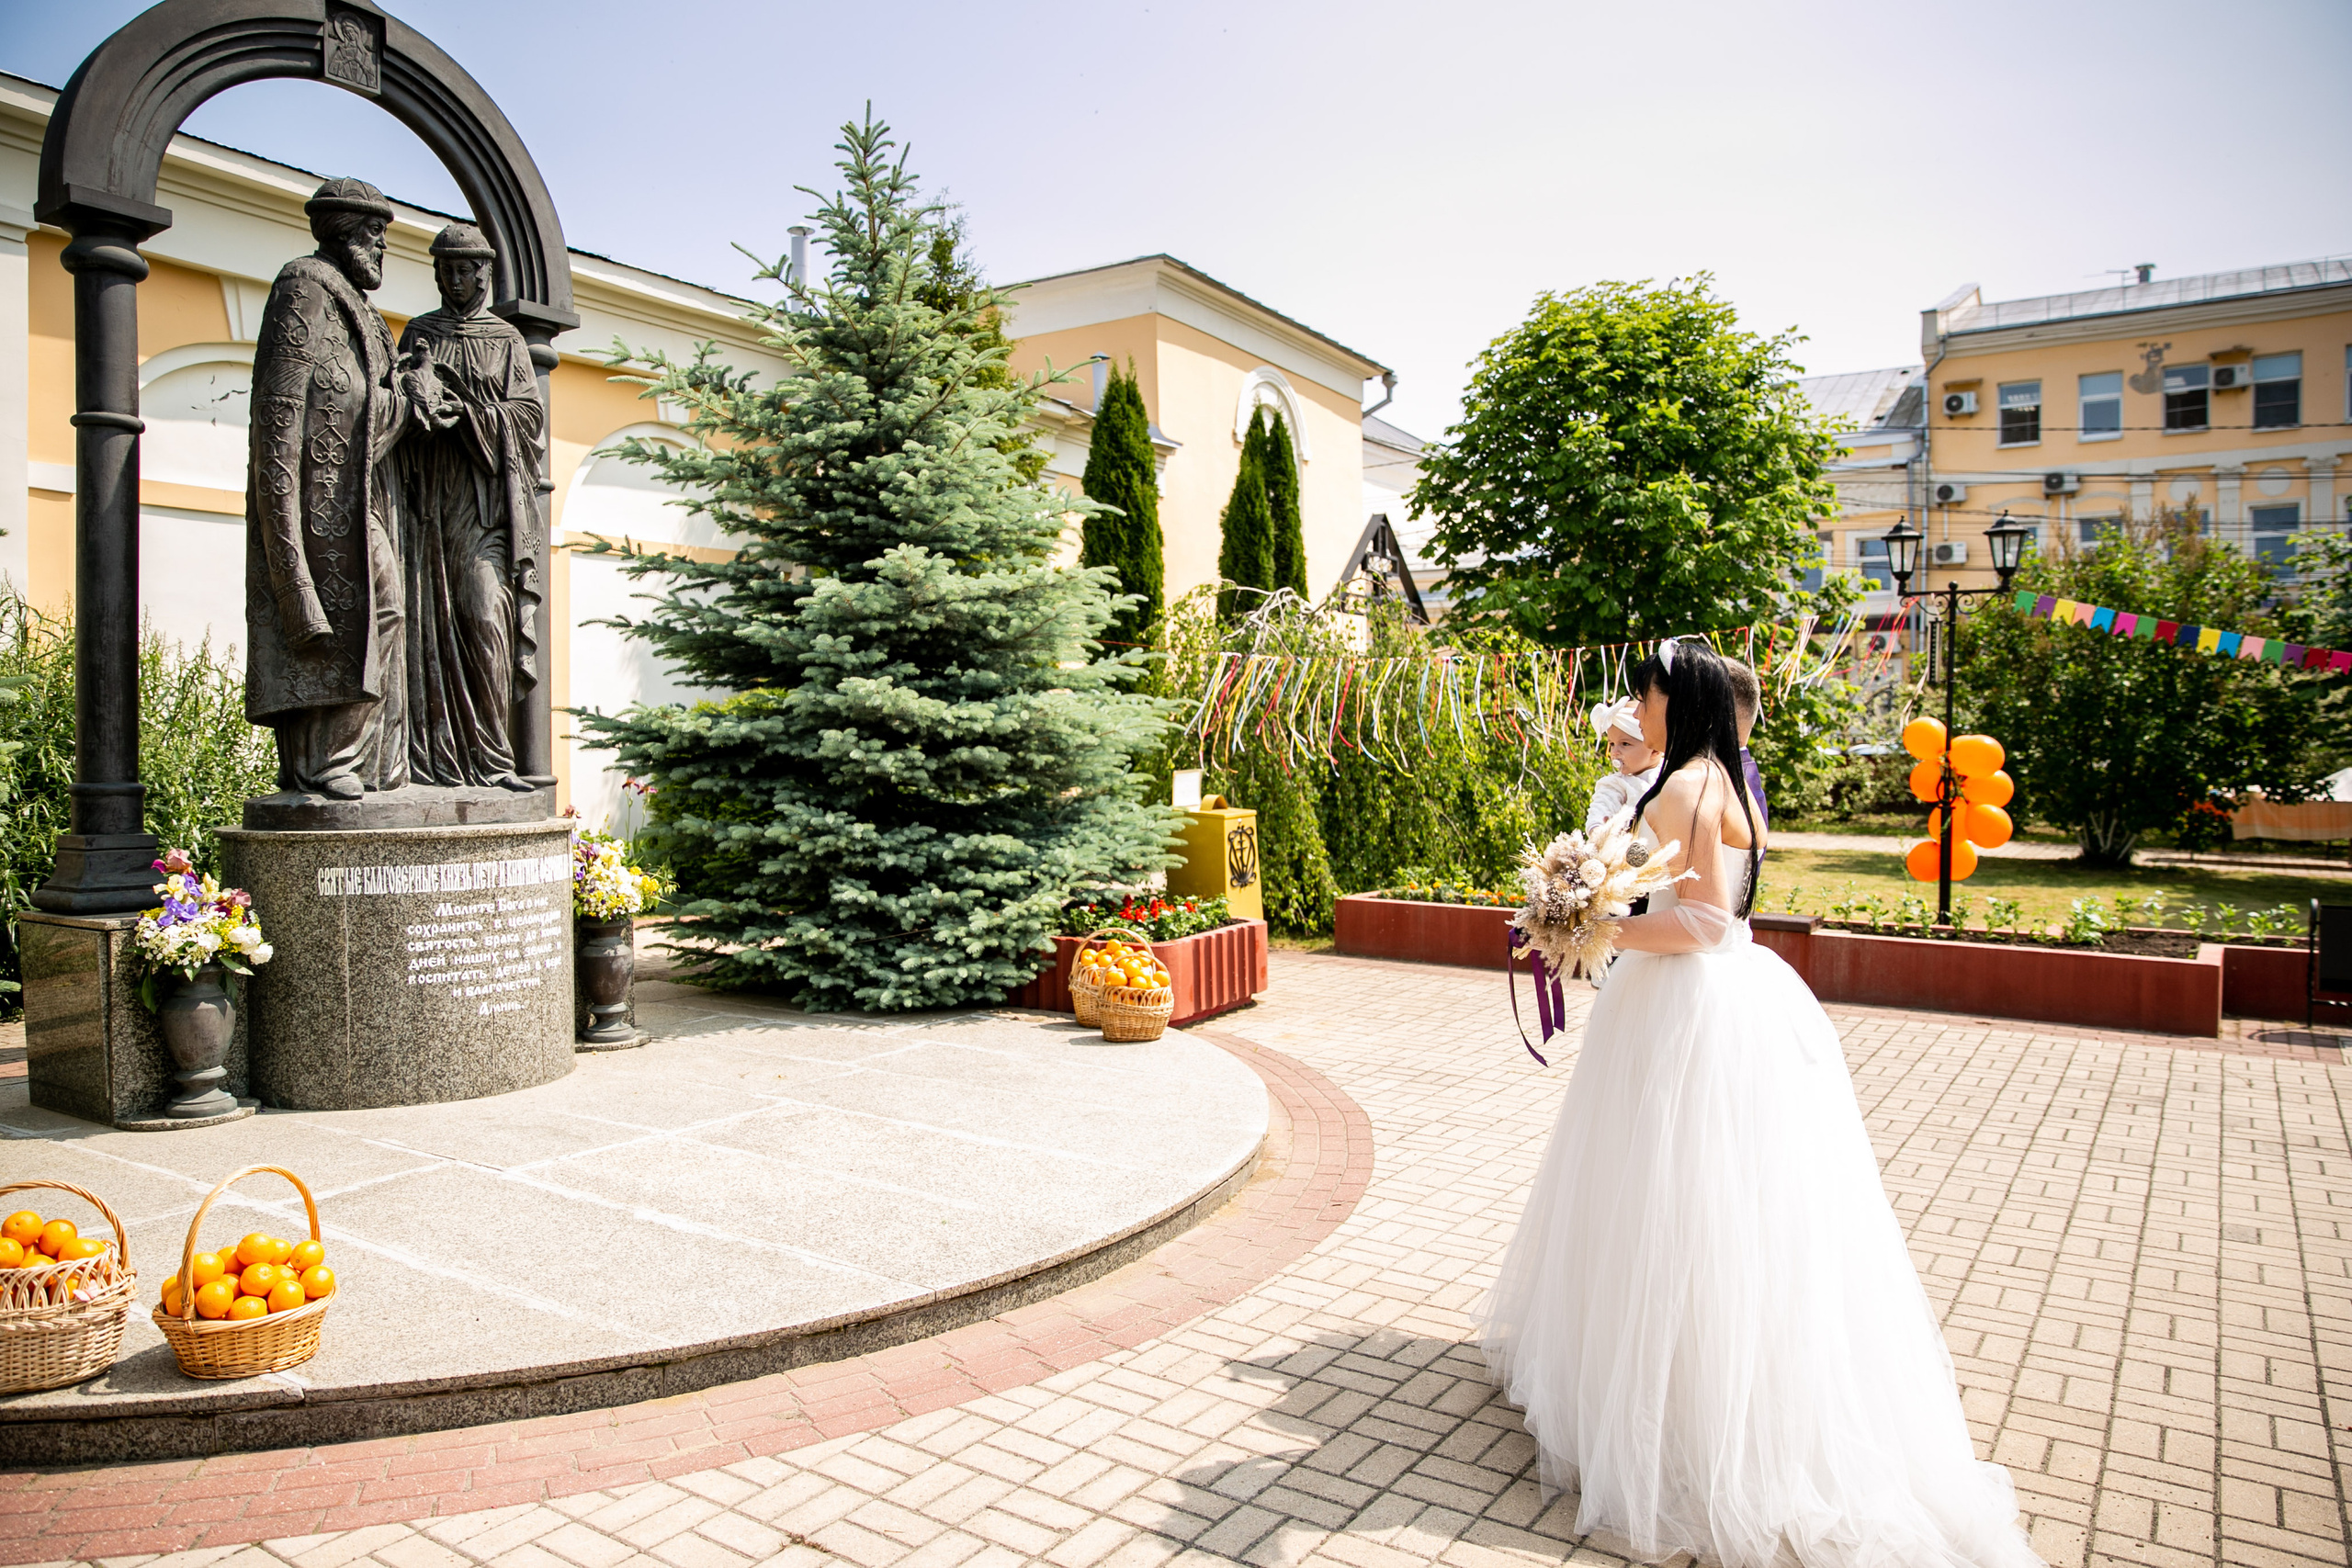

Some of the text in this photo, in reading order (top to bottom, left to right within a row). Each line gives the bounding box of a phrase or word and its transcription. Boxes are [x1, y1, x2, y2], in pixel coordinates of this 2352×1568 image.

[440, 863, 472, 891] КНЯЗЬ
[473, 862, 498, 889] ПЕТР
[499, 861, 505, 887] И
[435, 902, 495, 916] Молите
[498, 898, 524, 912] Бога
[407, 921, 482, 937] сохранить
[494, 919, 503, 929] в
[408, 938, 477, 952] святость
[484, 933, 520, 947] брака
[525, 931, 537, 943] до
[408, 954, 446, 970] дней
[454, 951, 499, 964] наших
[504, 949, 519, 959] на
[524, 943, 553, 956] земле
[409, 970, 487, 985] воспитать
[495, 960, 530, 978] детей
[453, 988, 461, 998] и
